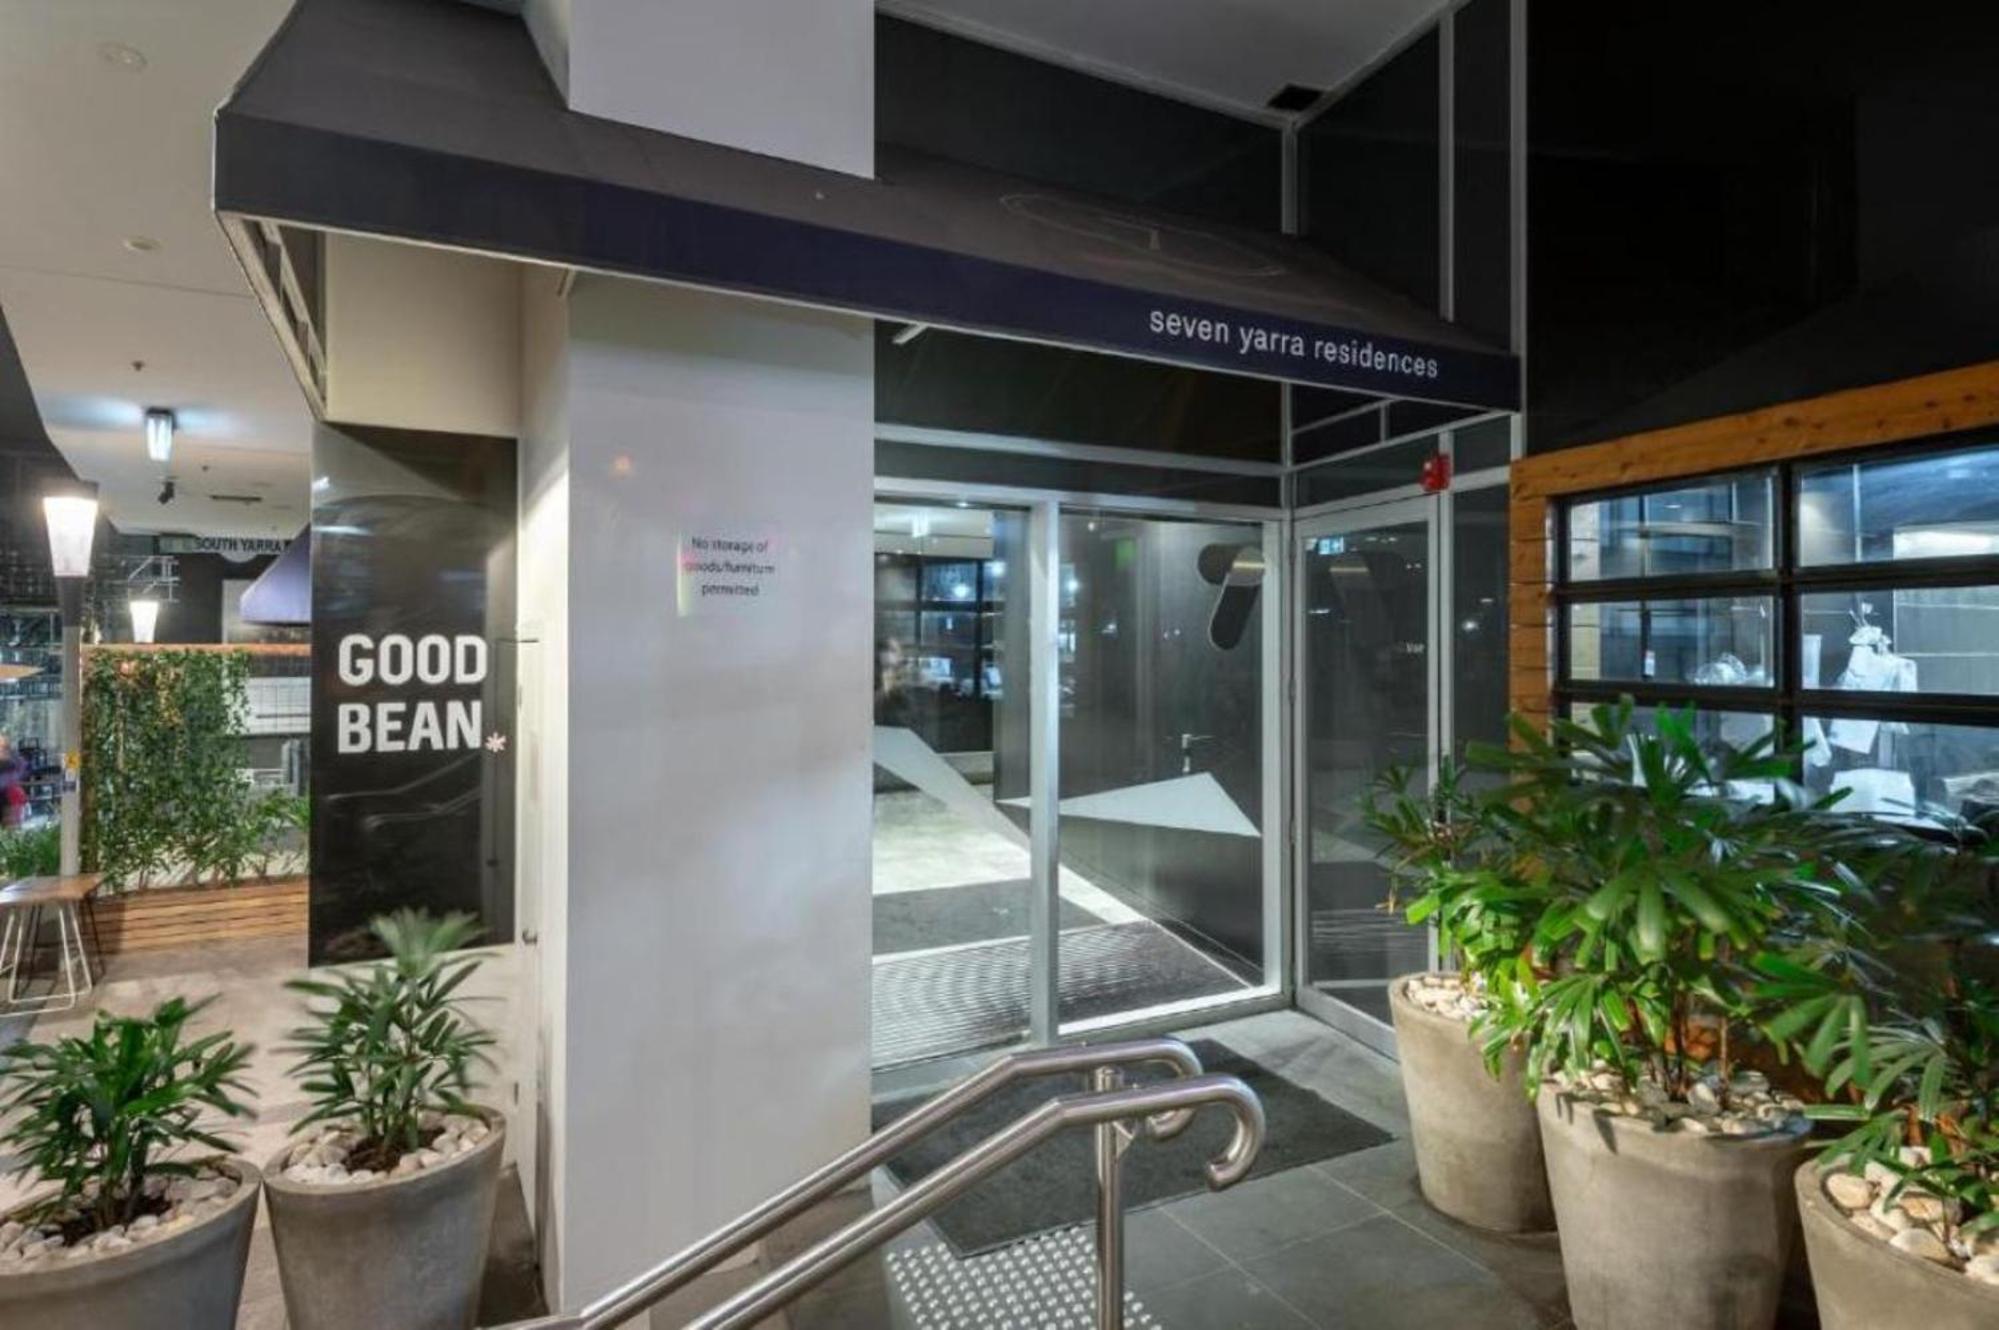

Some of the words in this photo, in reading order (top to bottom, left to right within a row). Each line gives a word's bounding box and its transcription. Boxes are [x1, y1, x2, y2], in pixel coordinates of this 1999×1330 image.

[1150, 310, 1229, 344] seven
[1240, 326, 1304, 356] yarra
[1315, 339, 1438, 379] residences
[197, 537, 237, 552] SOUTH
[240, 538, 281, 552] YARRA
[691, 536, 708, 550] No
[711, 538, 754, 555] storage
[756, 539, 769, 553] of
[701, 583, 760, 597] permitted
[338, 633, 487, 686] GOOD
[338, 700, 482, 755] BEAN
